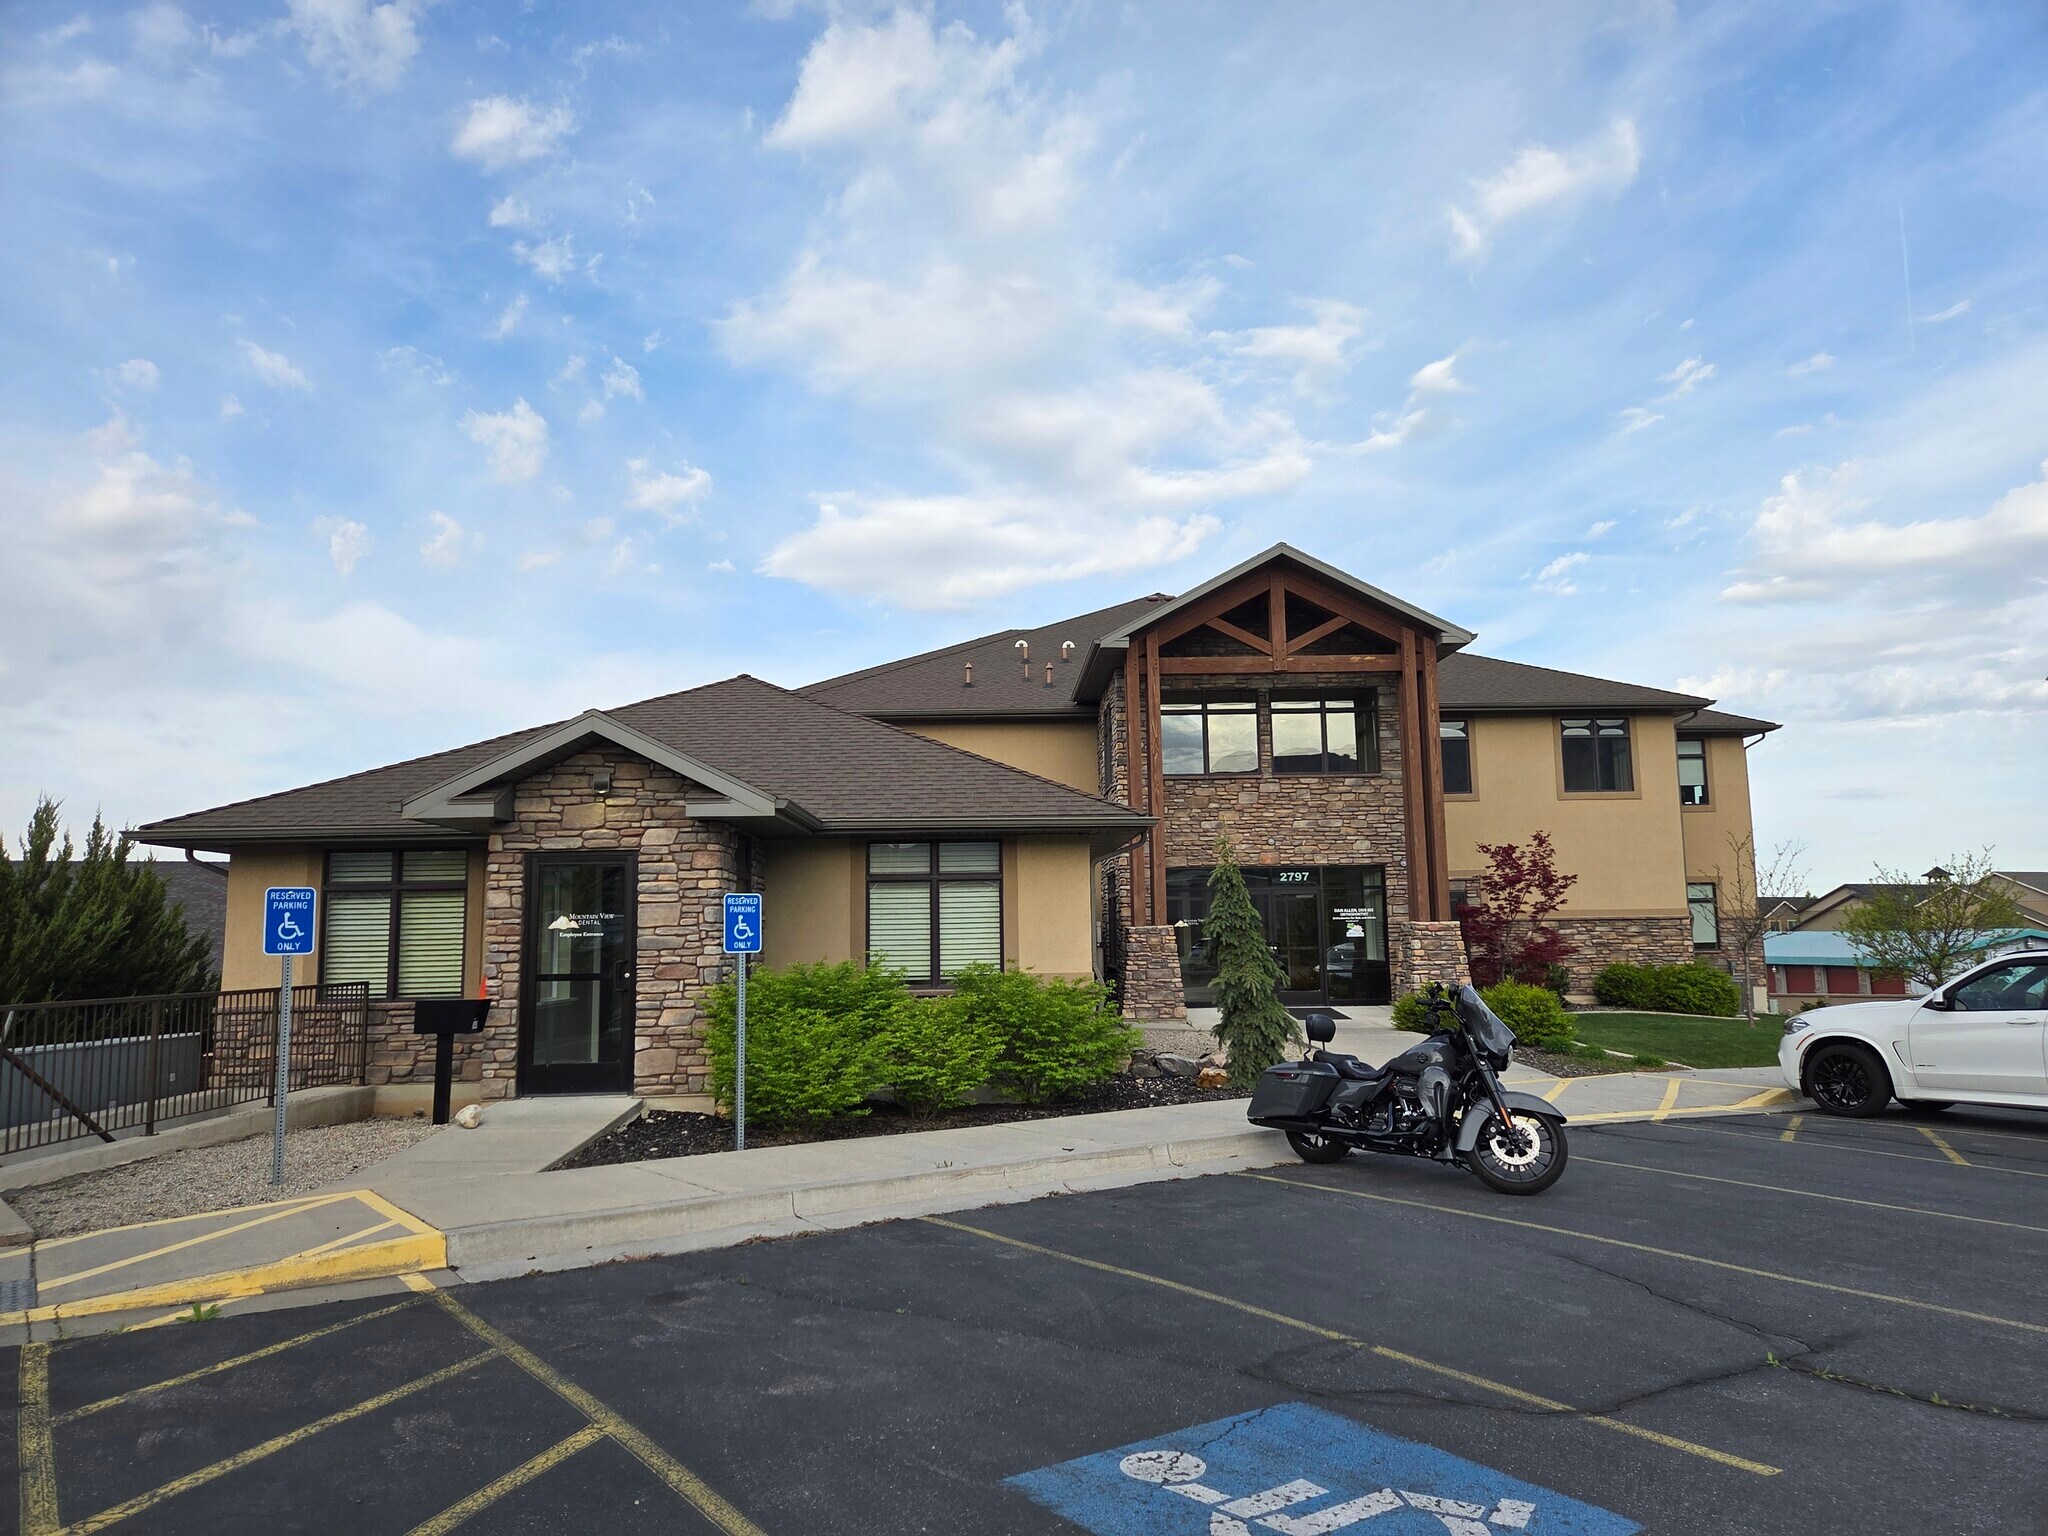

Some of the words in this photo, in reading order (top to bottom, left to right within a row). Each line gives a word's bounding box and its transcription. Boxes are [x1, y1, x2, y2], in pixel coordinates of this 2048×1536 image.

[1280, 872, 1310, 881] 2797
[270, 891, 311, 900] RESERVED
[273, 901, 308, 910] PARKING
[727, 897, 758, 905] RESERVED
[729, 905, 756, 913] PARKING
[277, 942, 301, 951] ONLY
[733, 941, 752, 949] ONLY
